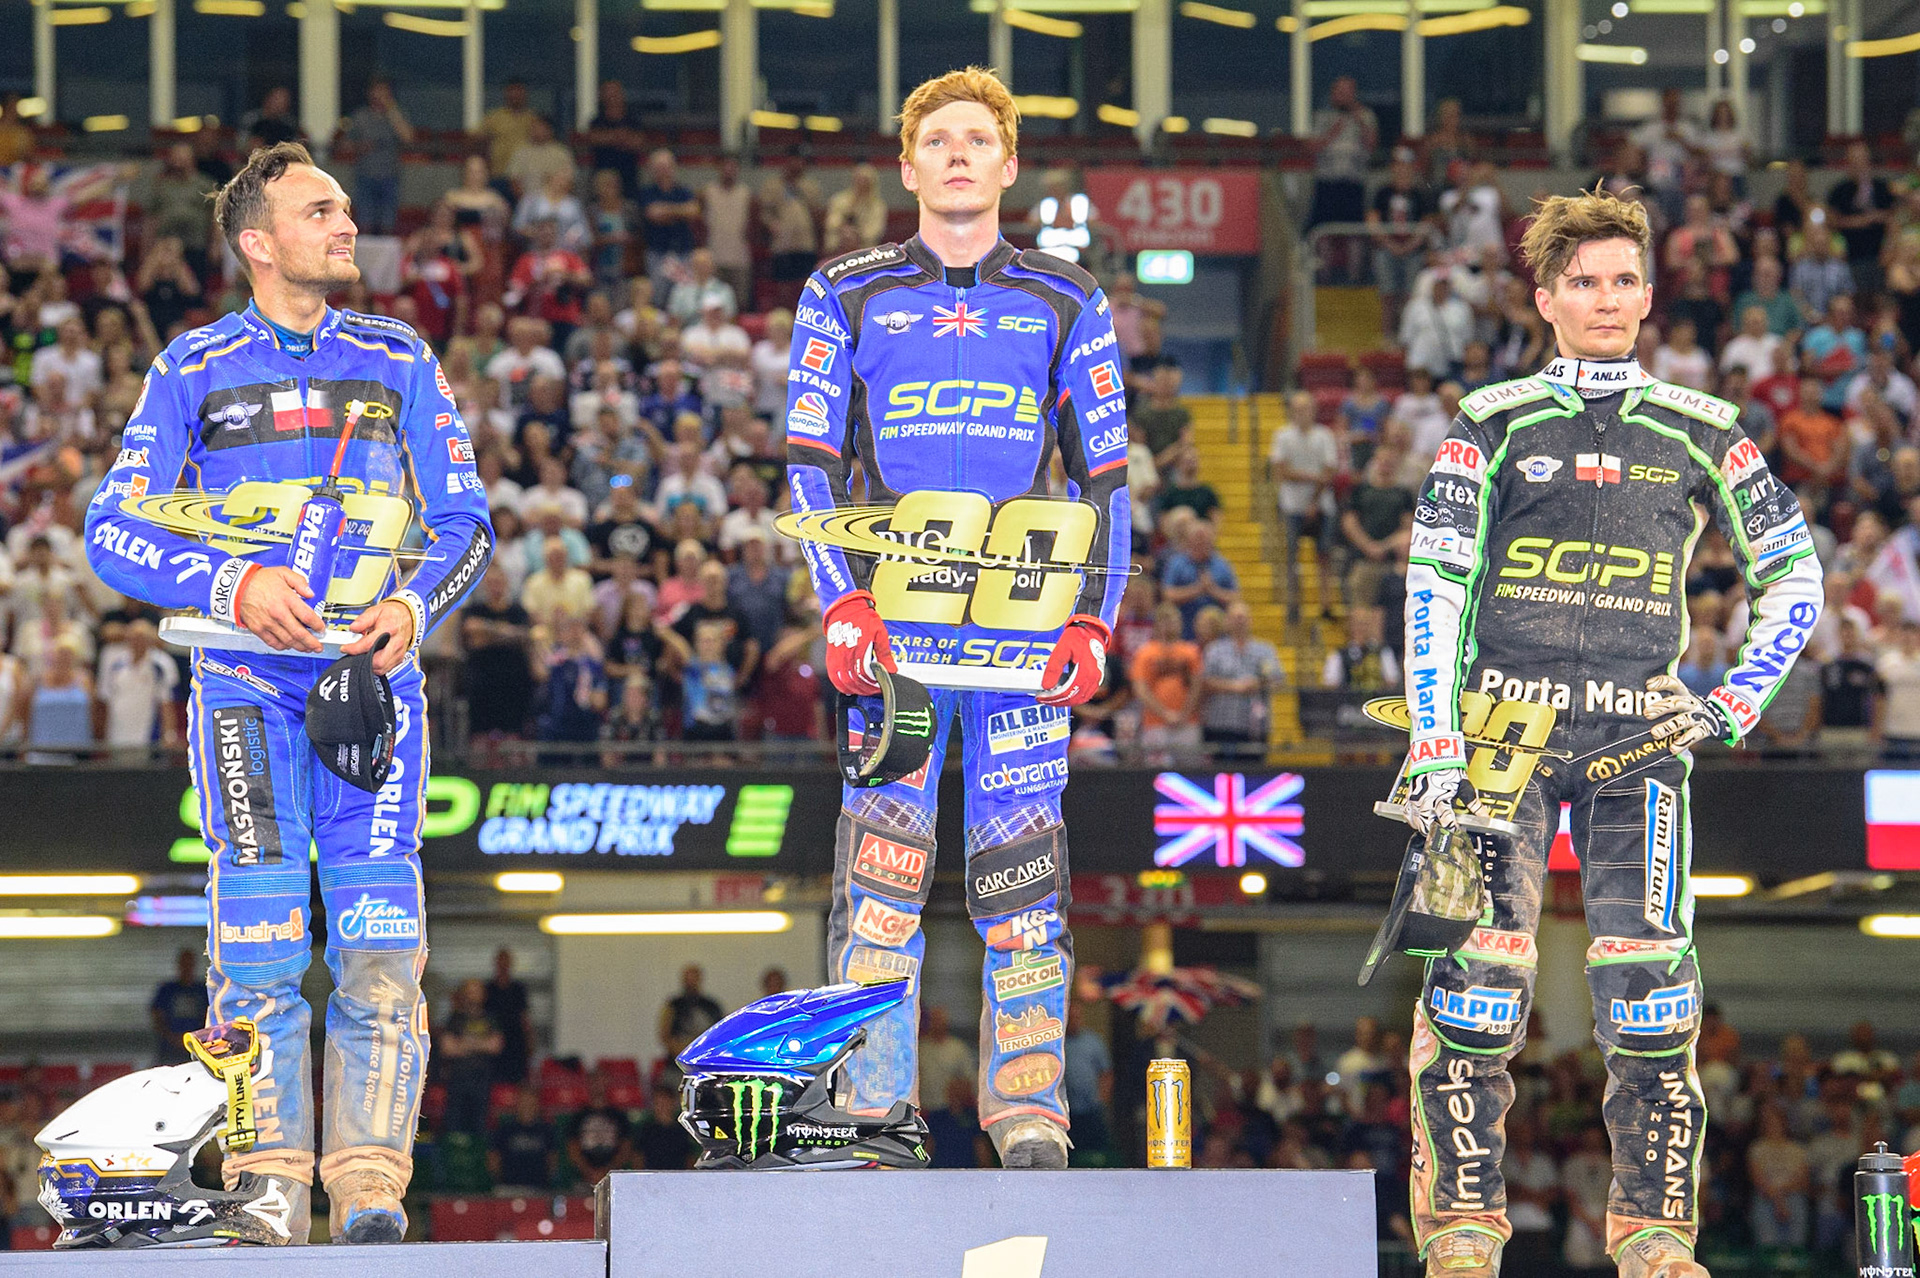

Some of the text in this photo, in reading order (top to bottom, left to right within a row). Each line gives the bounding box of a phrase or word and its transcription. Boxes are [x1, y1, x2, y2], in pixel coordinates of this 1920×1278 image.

[1116, 179, 1225, 227] 430
[189, 333, 226, 350] ORLEN
[997, 316, 1047, 334] SGP
[788, 369, 842, 398] BETARD
[1591, 370, 1628, 381] ANLAS
[884, 379, 1016, 421] SGP
[1469, 382, 1544, 413] LUMEL
[1651, 386, 1730, 421] LUMEL
[879, 422, 1036, 442] FIM SPEEDWAY GRAND PRIX
[1531, 464, 1546, 473] FIM
[1629, 464, 1680, 484] SGP
[93, 522, 165, 570] ORLEN
[1499, 537, 1650, 587] SGP
[1593, 593, 1644, 613] GRAND
[1645, 600, 1672, 616] PRIX
[937, 636, 958, 649] OF
[1730, 601, 1817, 693] Nice
[1412, 588, 1437, 732] Porta Mare
[339, 668, 350, 702] ORLEN
[1480, 669, 1570, 711] Porta
[989, 703, 1068, 735] ALBON
[243, 717, 264, 777] logistic
[1024, 731, 1048, 748] plc
[980, 757, 1068, 792] colorama
[1015, 778, 1068, 796] KUNGSGATAN
[219, 718, 258, 865] MASZOŃSKI
[369, 758, 405, 858] ORLEN
[484, 784, 726, 825] FIM SPEEDWAY
[478, 819, 597, 855] GRAND
[590, 818, 679, 855] PRIX
[862, 840, 925, 874] AMD
[1648, 791, 1673, 917] Rami Truck
[860, 862, 918, 885] GROUP
[975, 853, 1056, 895] GARCAREK
[220, 907, 304, 943] budnex
[370, 920, 416, 934] ORLEN
[862, 903, 915, 936] NGK
[1478, 931, 1529, 954] KAPI
[852, 947, 918, 977] ALBON
[997, 966, 1062, 993] ROCK OIL
[1432, 988, 1520, 1022] ARPOL
[1612, 996, 1697, 1022] ARPOL
[1489, 1023, 1511, 1034] 1991
[364, 1071, 380, 1115] Broker
[392, 1040, 416, 1137] Grohmann
[1007, 1069, 1051, 1091] JHI
[786, 1125, 858, 1138] MONSTER
[1437, 1058, 1490, 1210] Impeks
[88, 1201, 172, 1220] ORLEN
